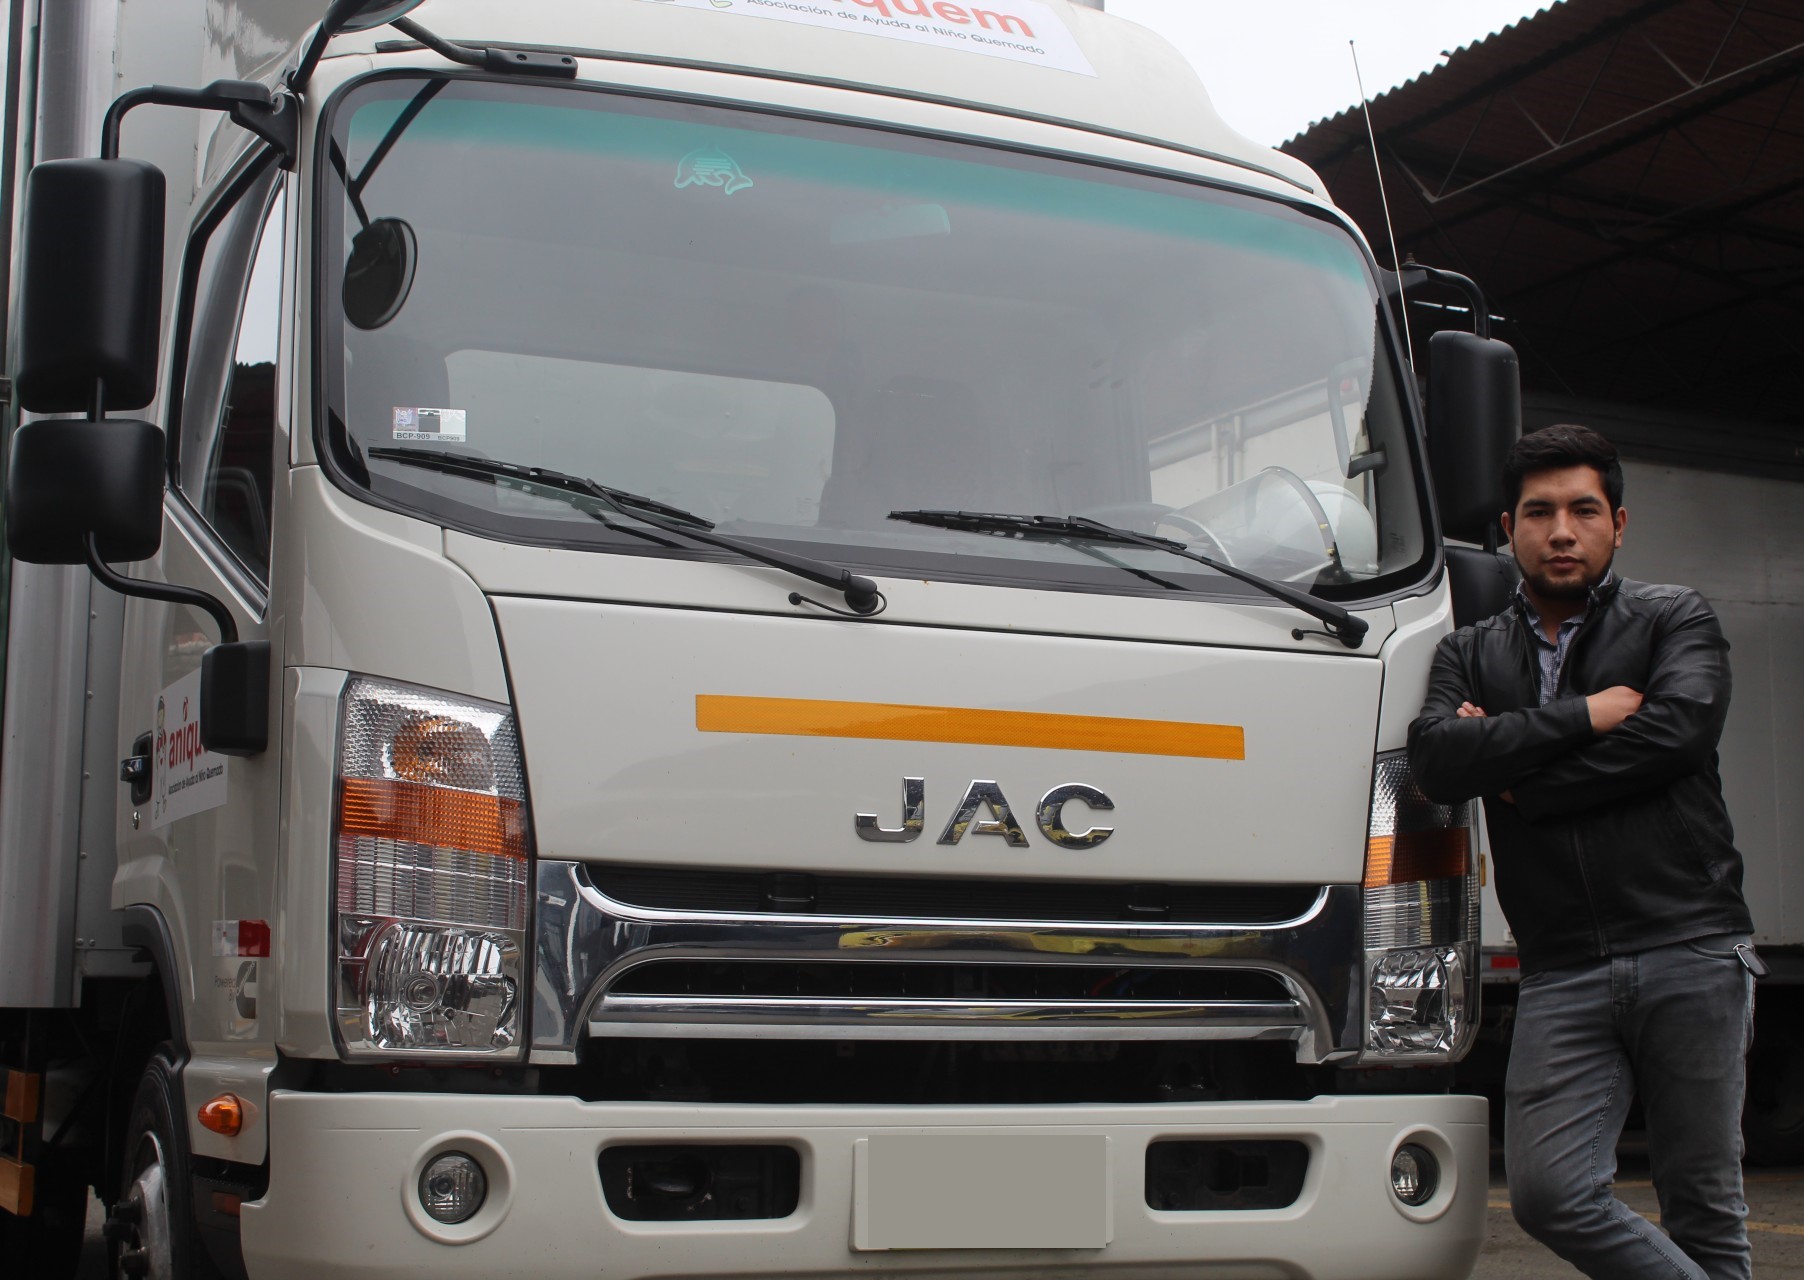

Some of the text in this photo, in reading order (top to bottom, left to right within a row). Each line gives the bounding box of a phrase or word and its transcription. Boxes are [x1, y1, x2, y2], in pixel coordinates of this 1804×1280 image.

[837, 10, 858, 21] de
[863, 14, 911, 30] Ayuda
[915, 24, 930, 33] al
[932, 26, 967, 40] Niño
[970, 33, 1045, 55] Quemado
[396, 432, 431, 440] BCP-909
[168, 720, 209, 772] aniqu
[855, 776, 1116, 850] JAC
